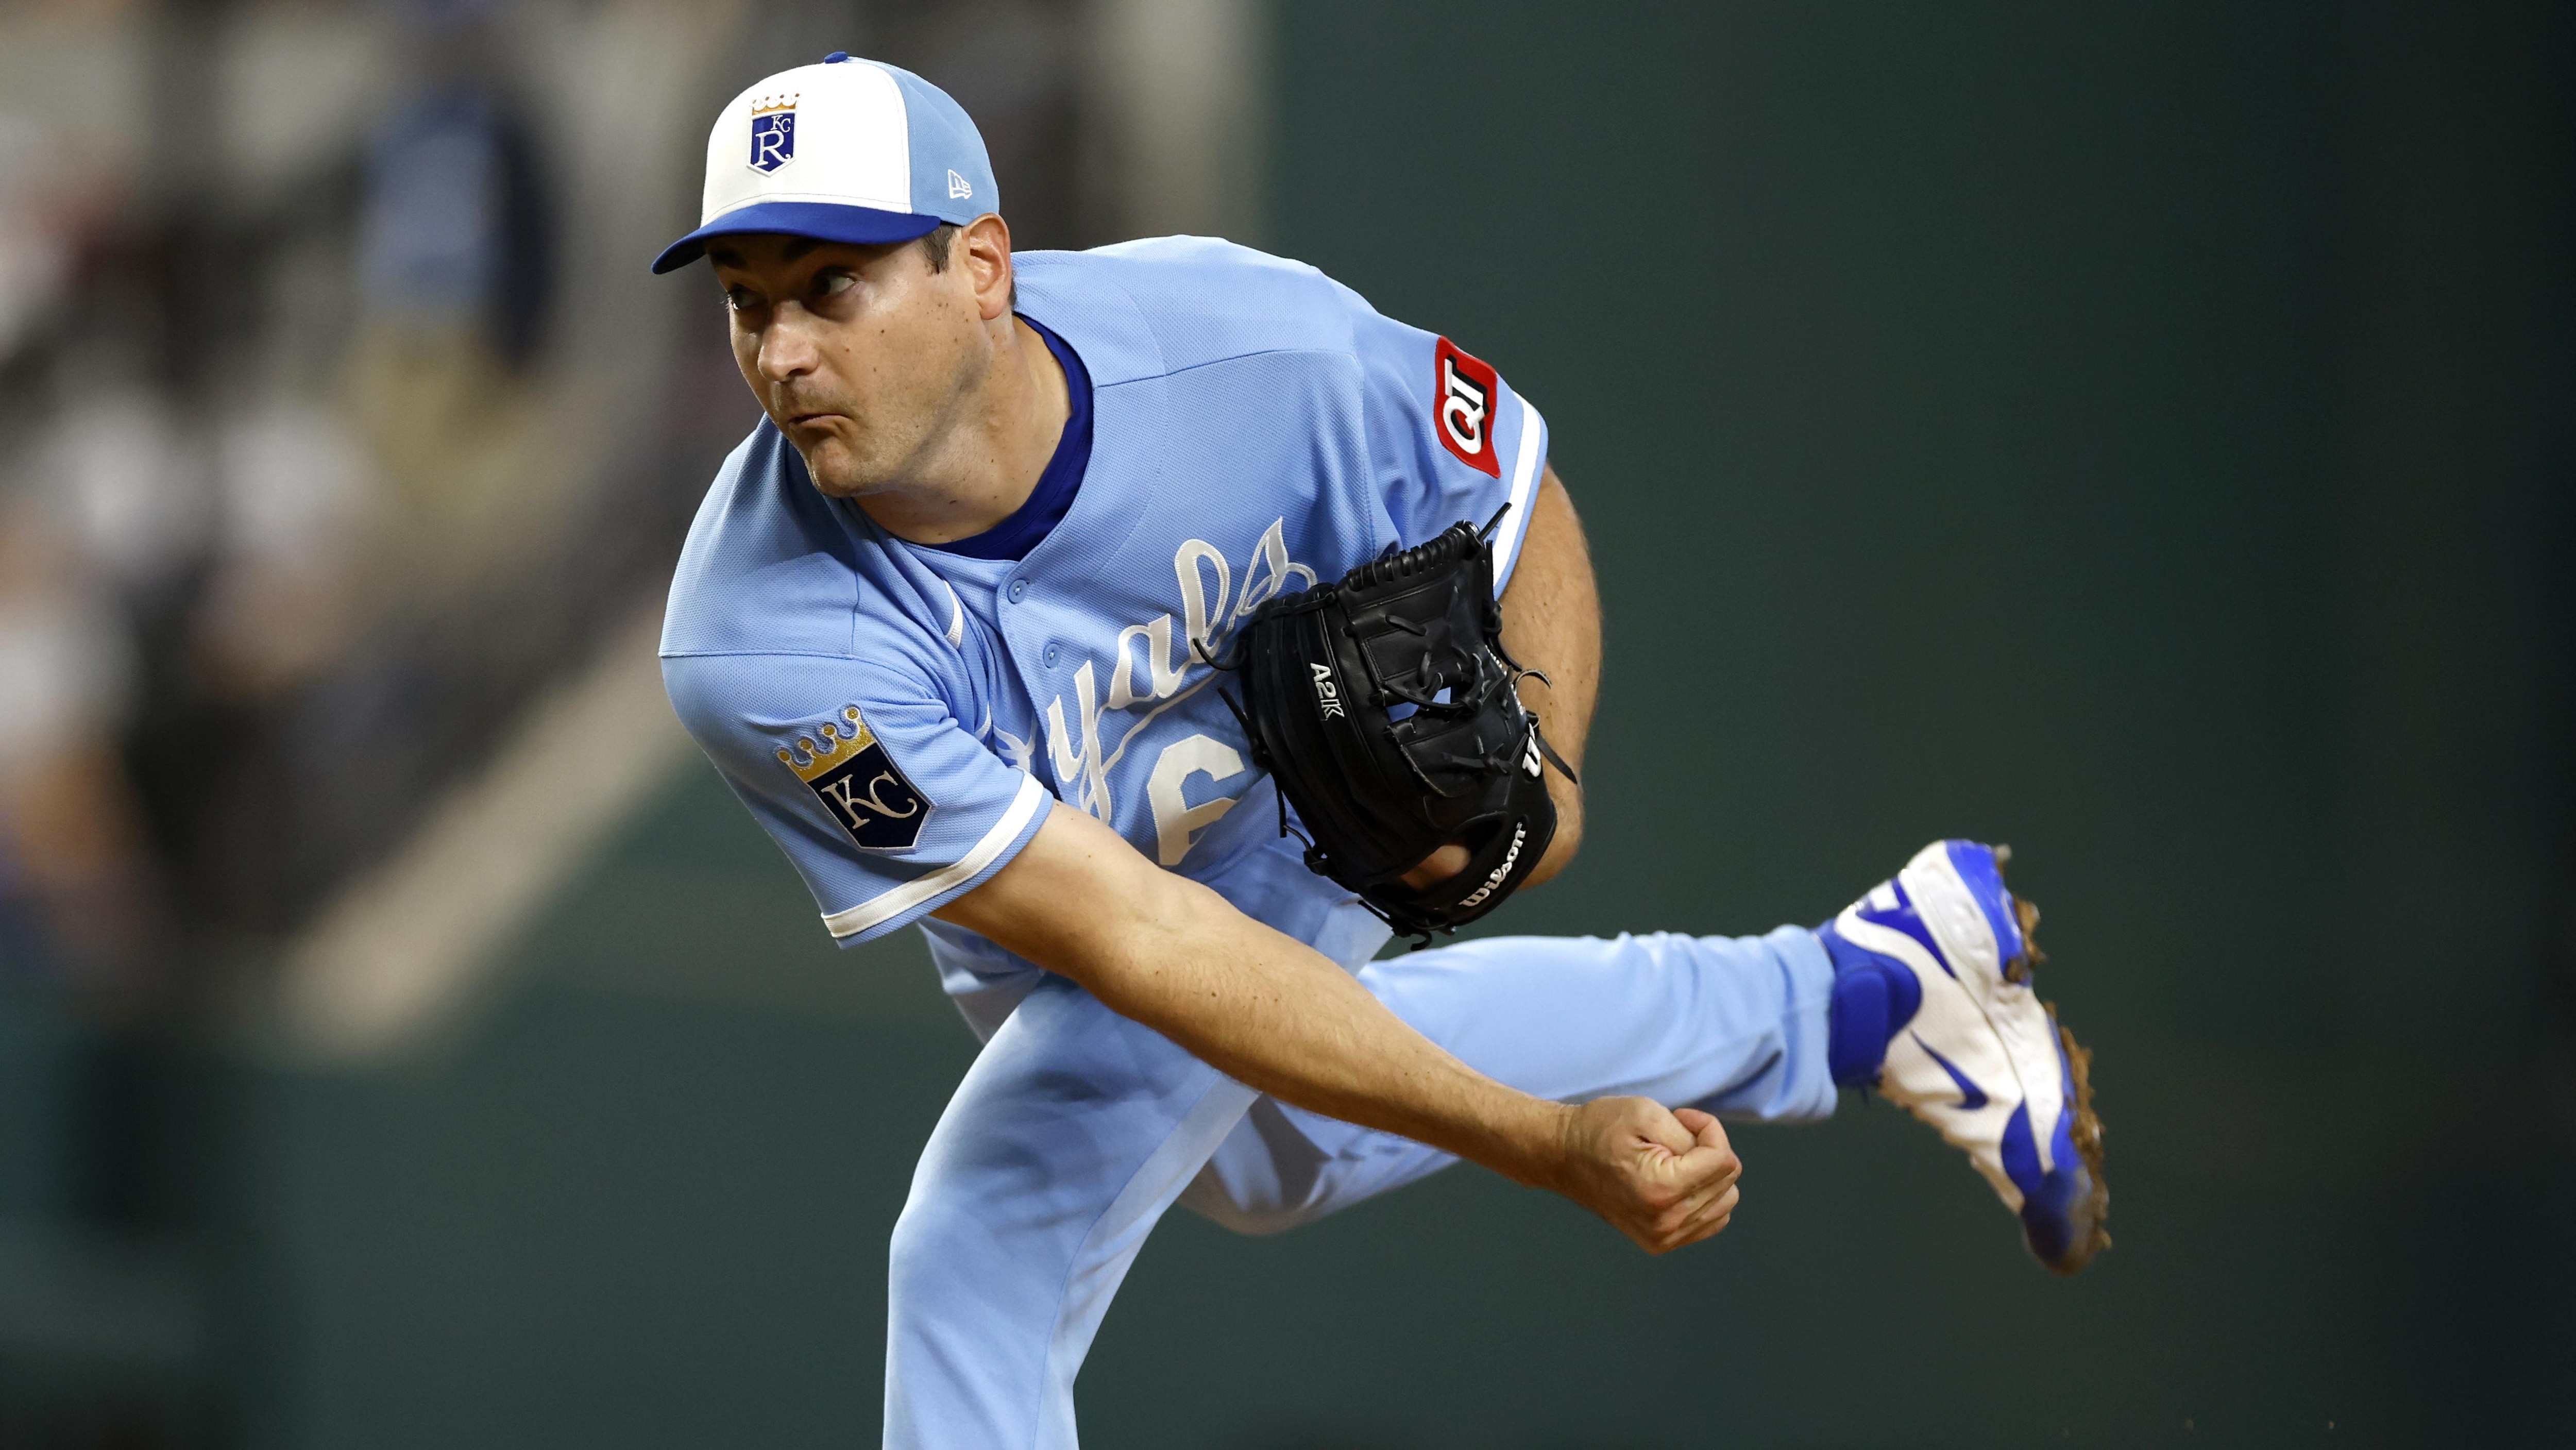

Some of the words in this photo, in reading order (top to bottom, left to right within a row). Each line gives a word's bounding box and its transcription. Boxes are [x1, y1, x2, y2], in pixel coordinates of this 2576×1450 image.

[754, 130, 791, 166] R
[770, 114, 791, 132] KC
[1443, 358, 1485, 453] QT
[820, 770, 918, 830] KC
[1459, 829, 1526, 906] Wilson
